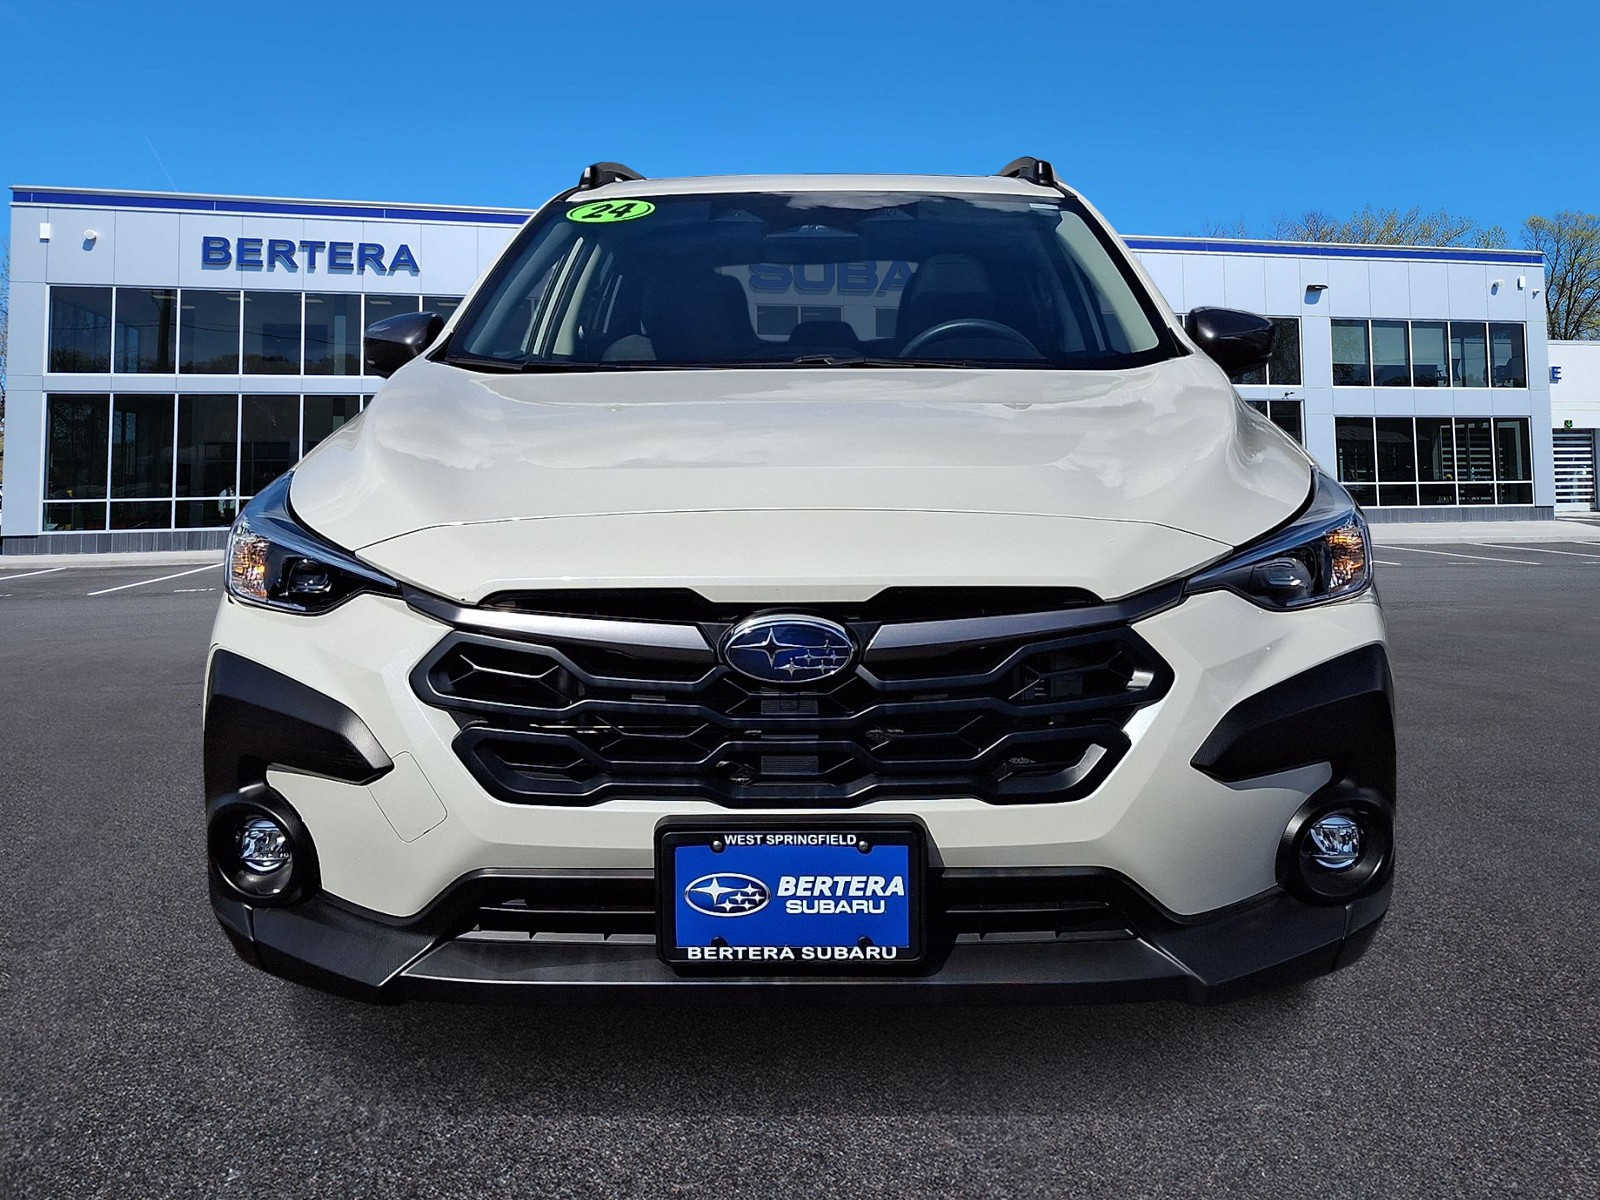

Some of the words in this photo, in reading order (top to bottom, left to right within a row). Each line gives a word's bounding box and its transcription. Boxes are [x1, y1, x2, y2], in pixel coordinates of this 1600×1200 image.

[581, 203, 638, 219] 24
[202, 236, 420, 273] BERTERA
[724, 834, 763, 846] WEST
[766, 834, 857, 846] SPRINGFIELD
[777, 875, 905, 897] BERTERA
[785, 899, 886, 914] SUBARU
[687, 946, 795, 960] BERTERA
[801, 946, 897, 960] SUBARU
